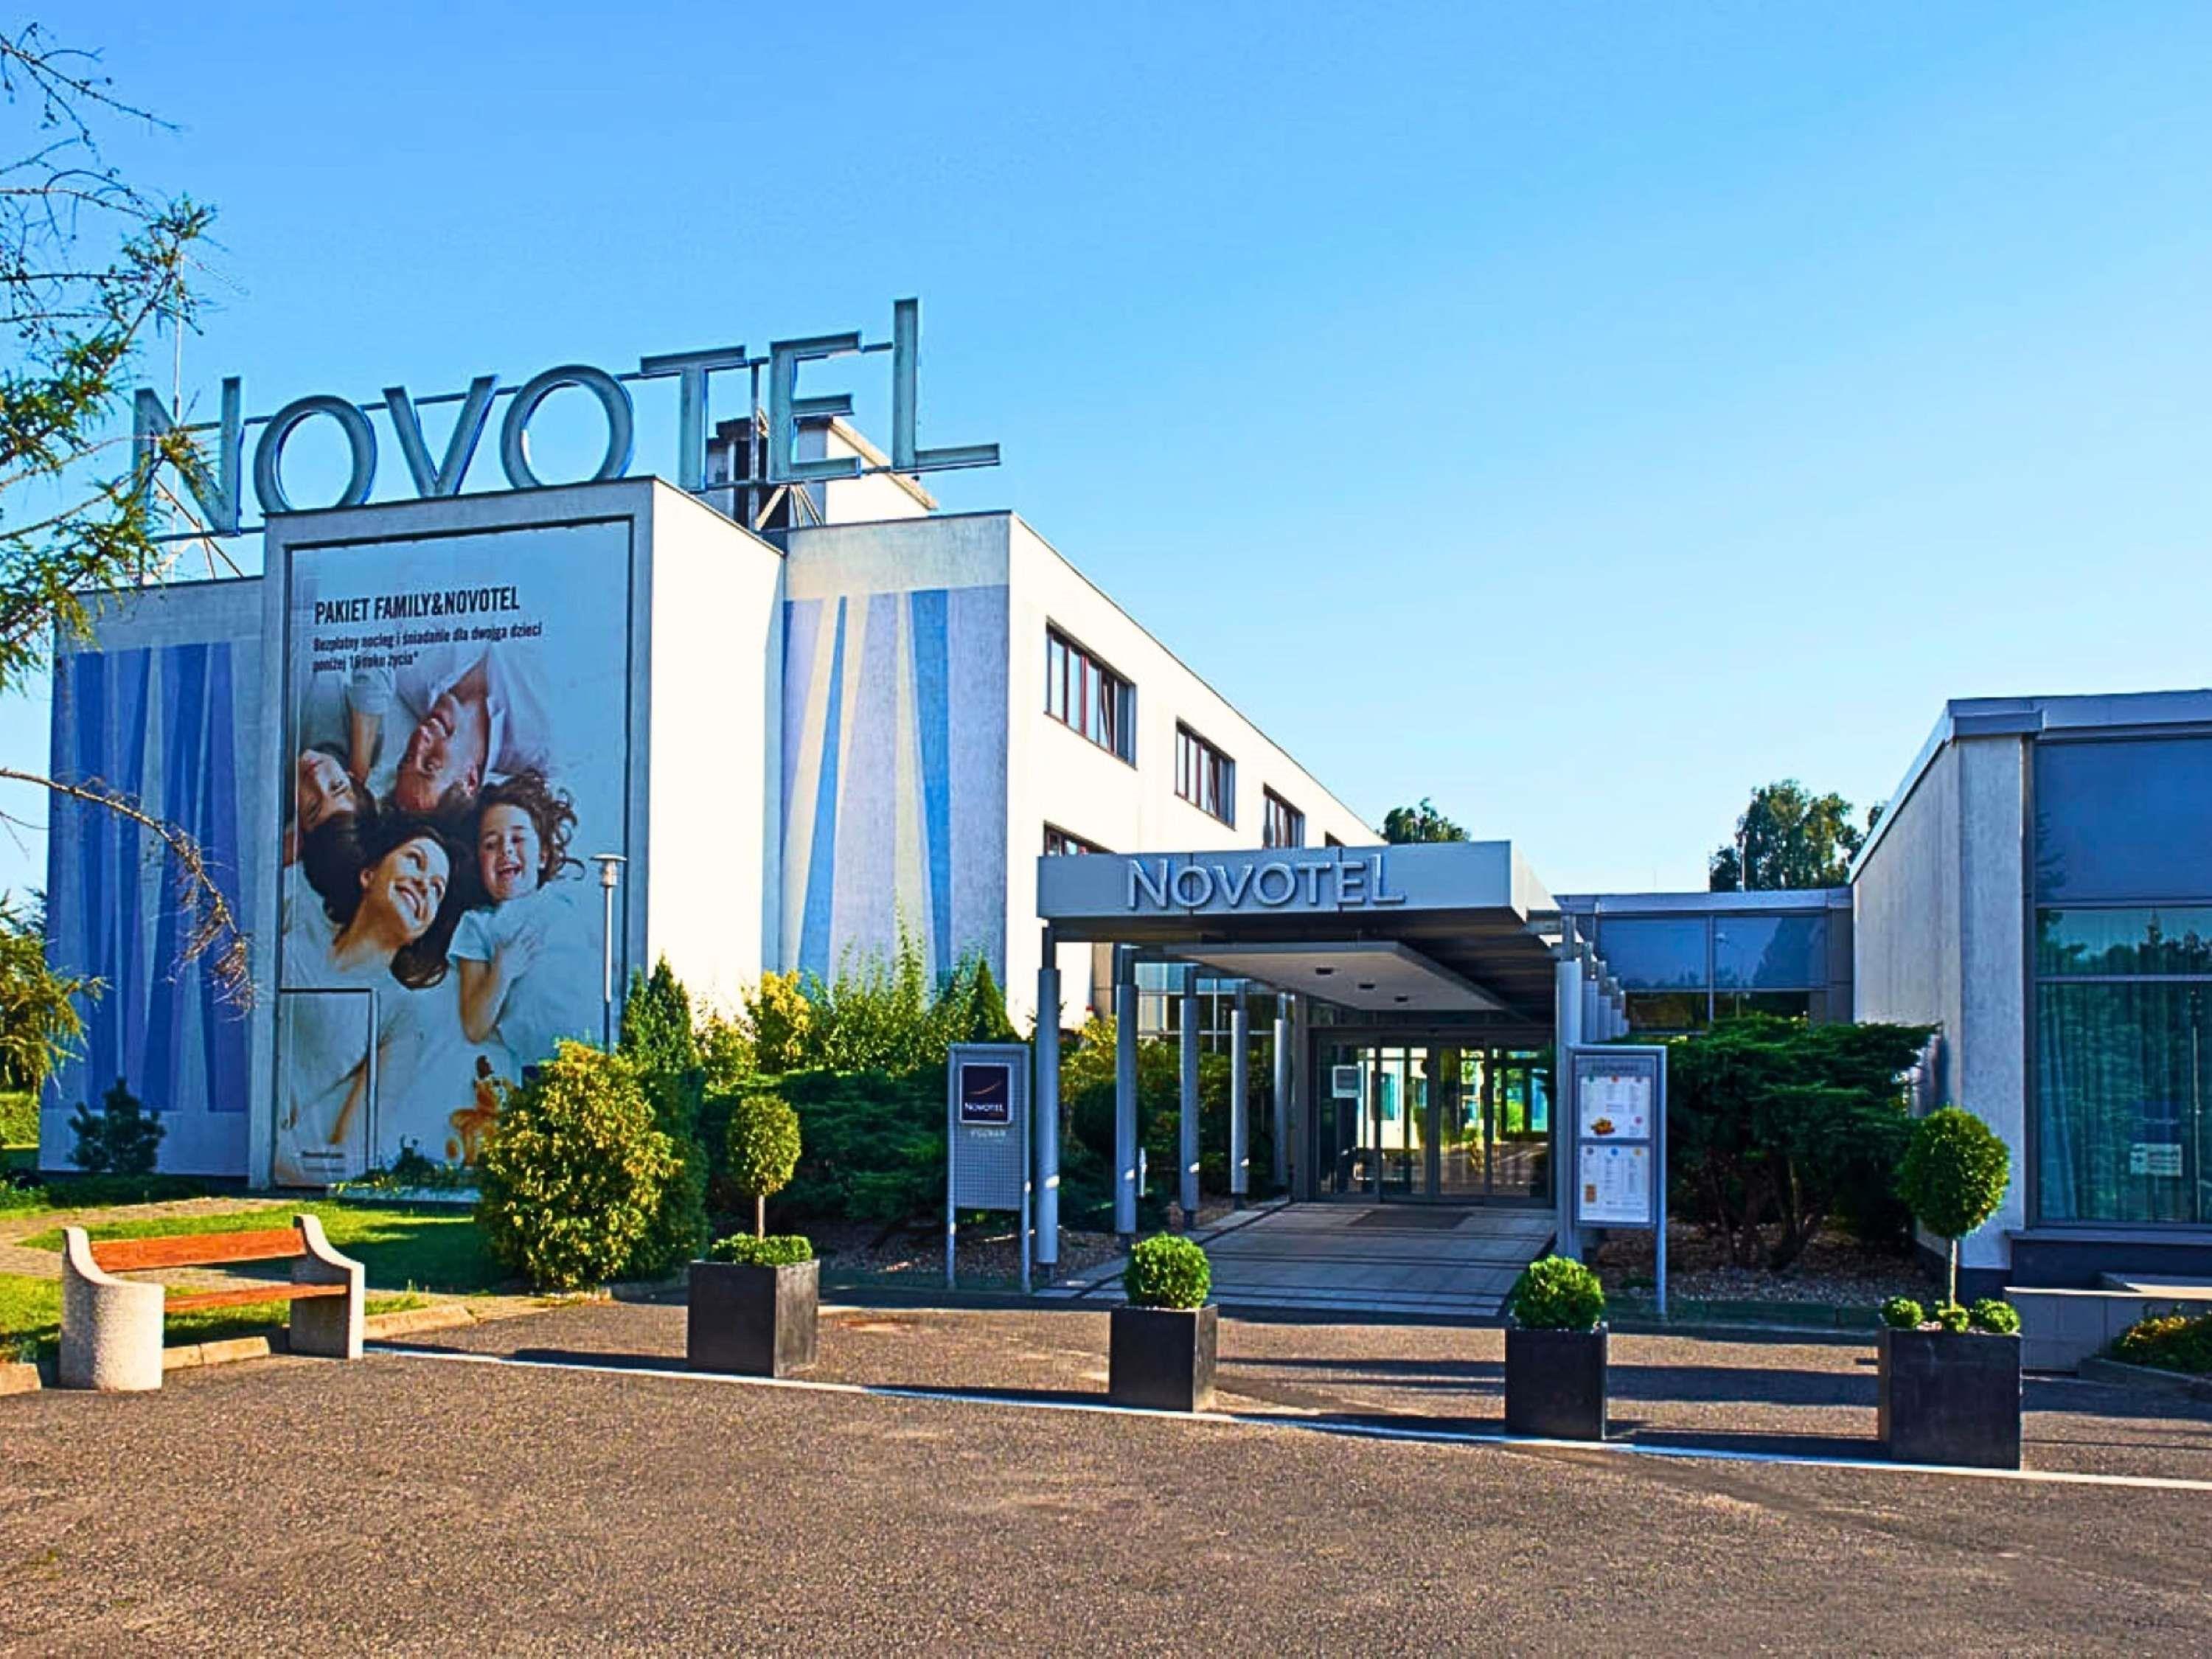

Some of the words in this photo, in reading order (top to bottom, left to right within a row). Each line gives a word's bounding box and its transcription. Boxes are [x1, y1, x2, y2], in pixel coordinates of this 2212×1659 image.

[133, 298, 1001, 537] NOVOTEL
[315, 597, 370, 625] PAKIET
[374, 586, 520, 620] FAMILY&NOVOTEL
[453, 627, 468, 641] dla
[472, 625, 507, 641] dwojga
[510, 622, 542, 638] dzieci
[1127, 853, 1406, 910] NOVOTEL
